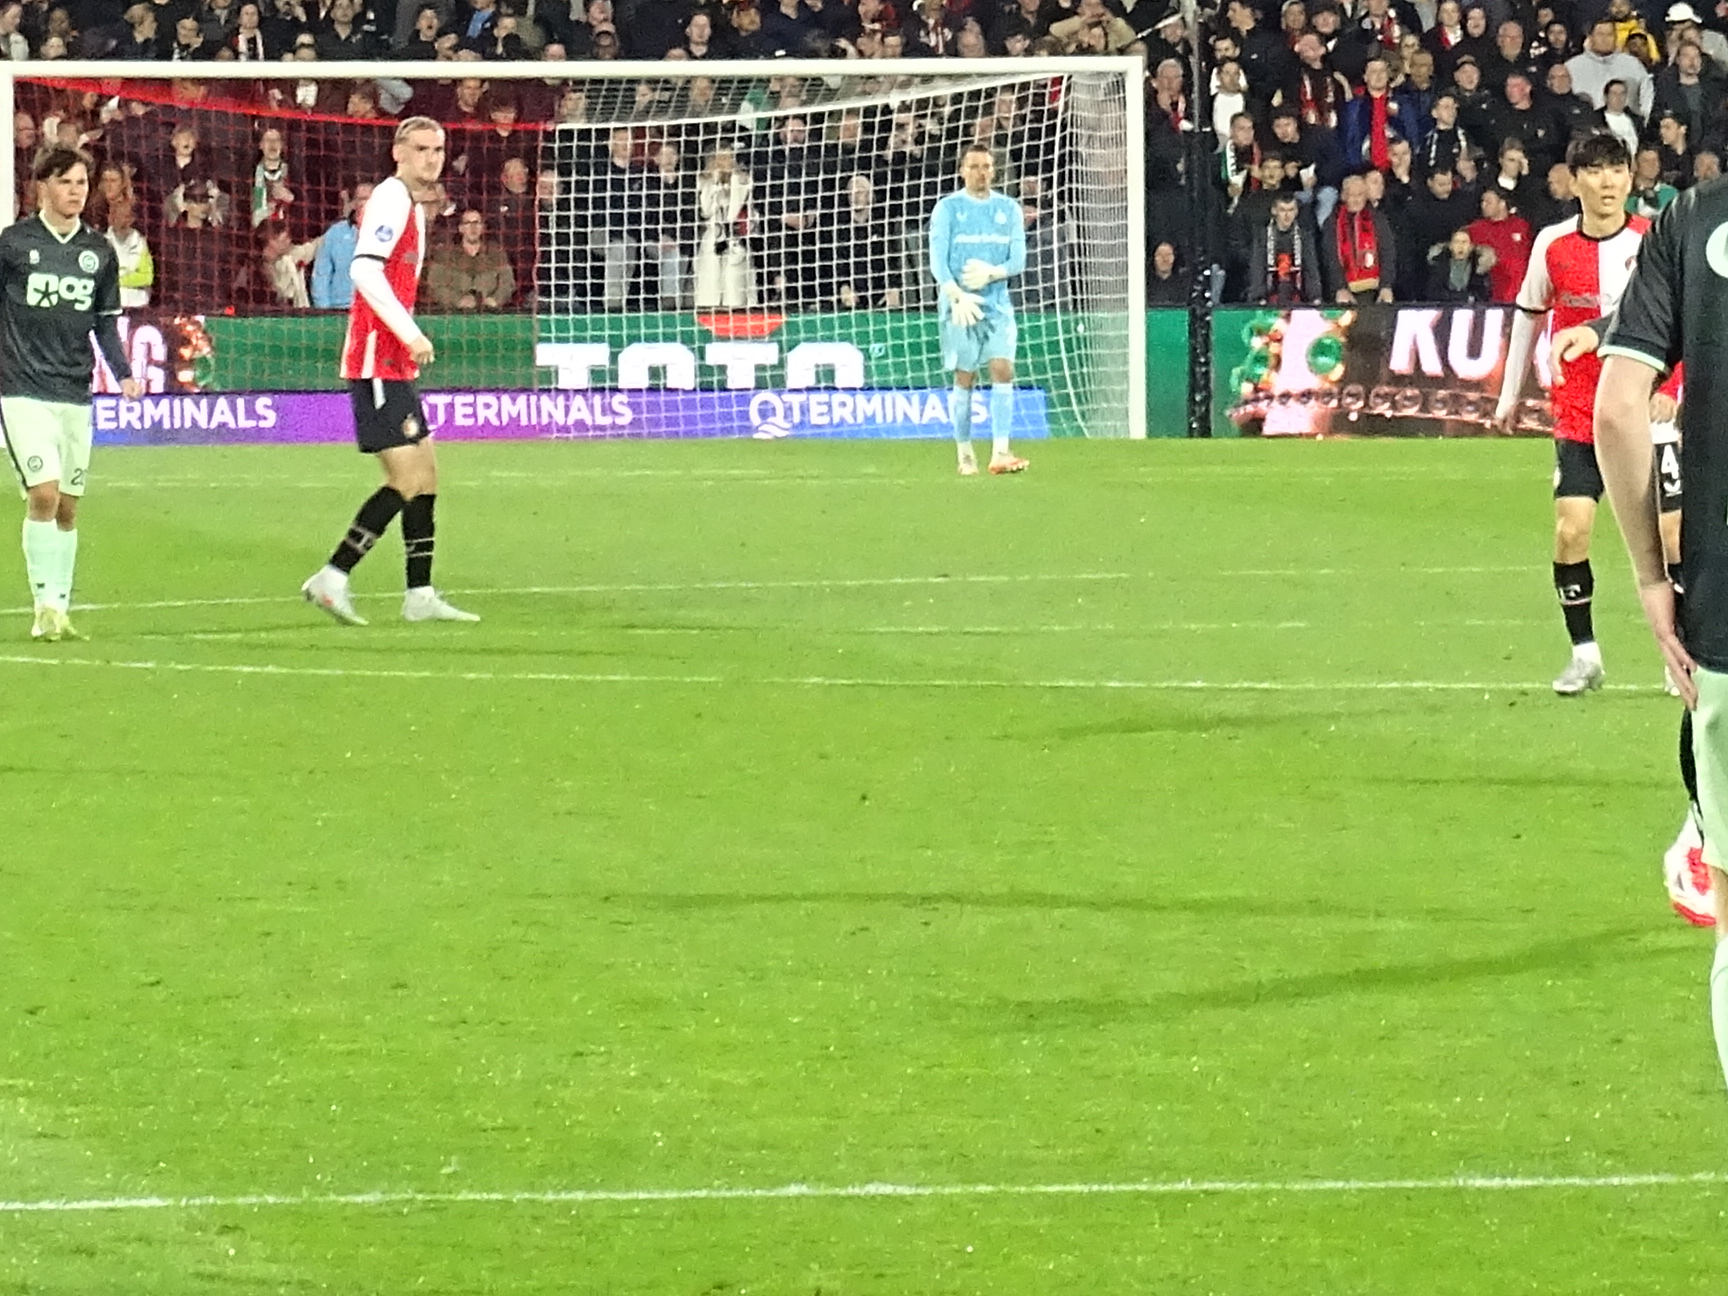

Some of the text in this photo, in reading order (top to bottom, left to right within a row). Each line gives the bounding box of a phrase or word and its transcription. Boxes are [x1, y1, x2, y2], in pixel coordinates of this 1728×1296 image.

[95, 397, 277, 429] ERMINALS
[422, 393, 634, 427] TERMINALS
[749, 392, 988, 430] QTERMINAS
